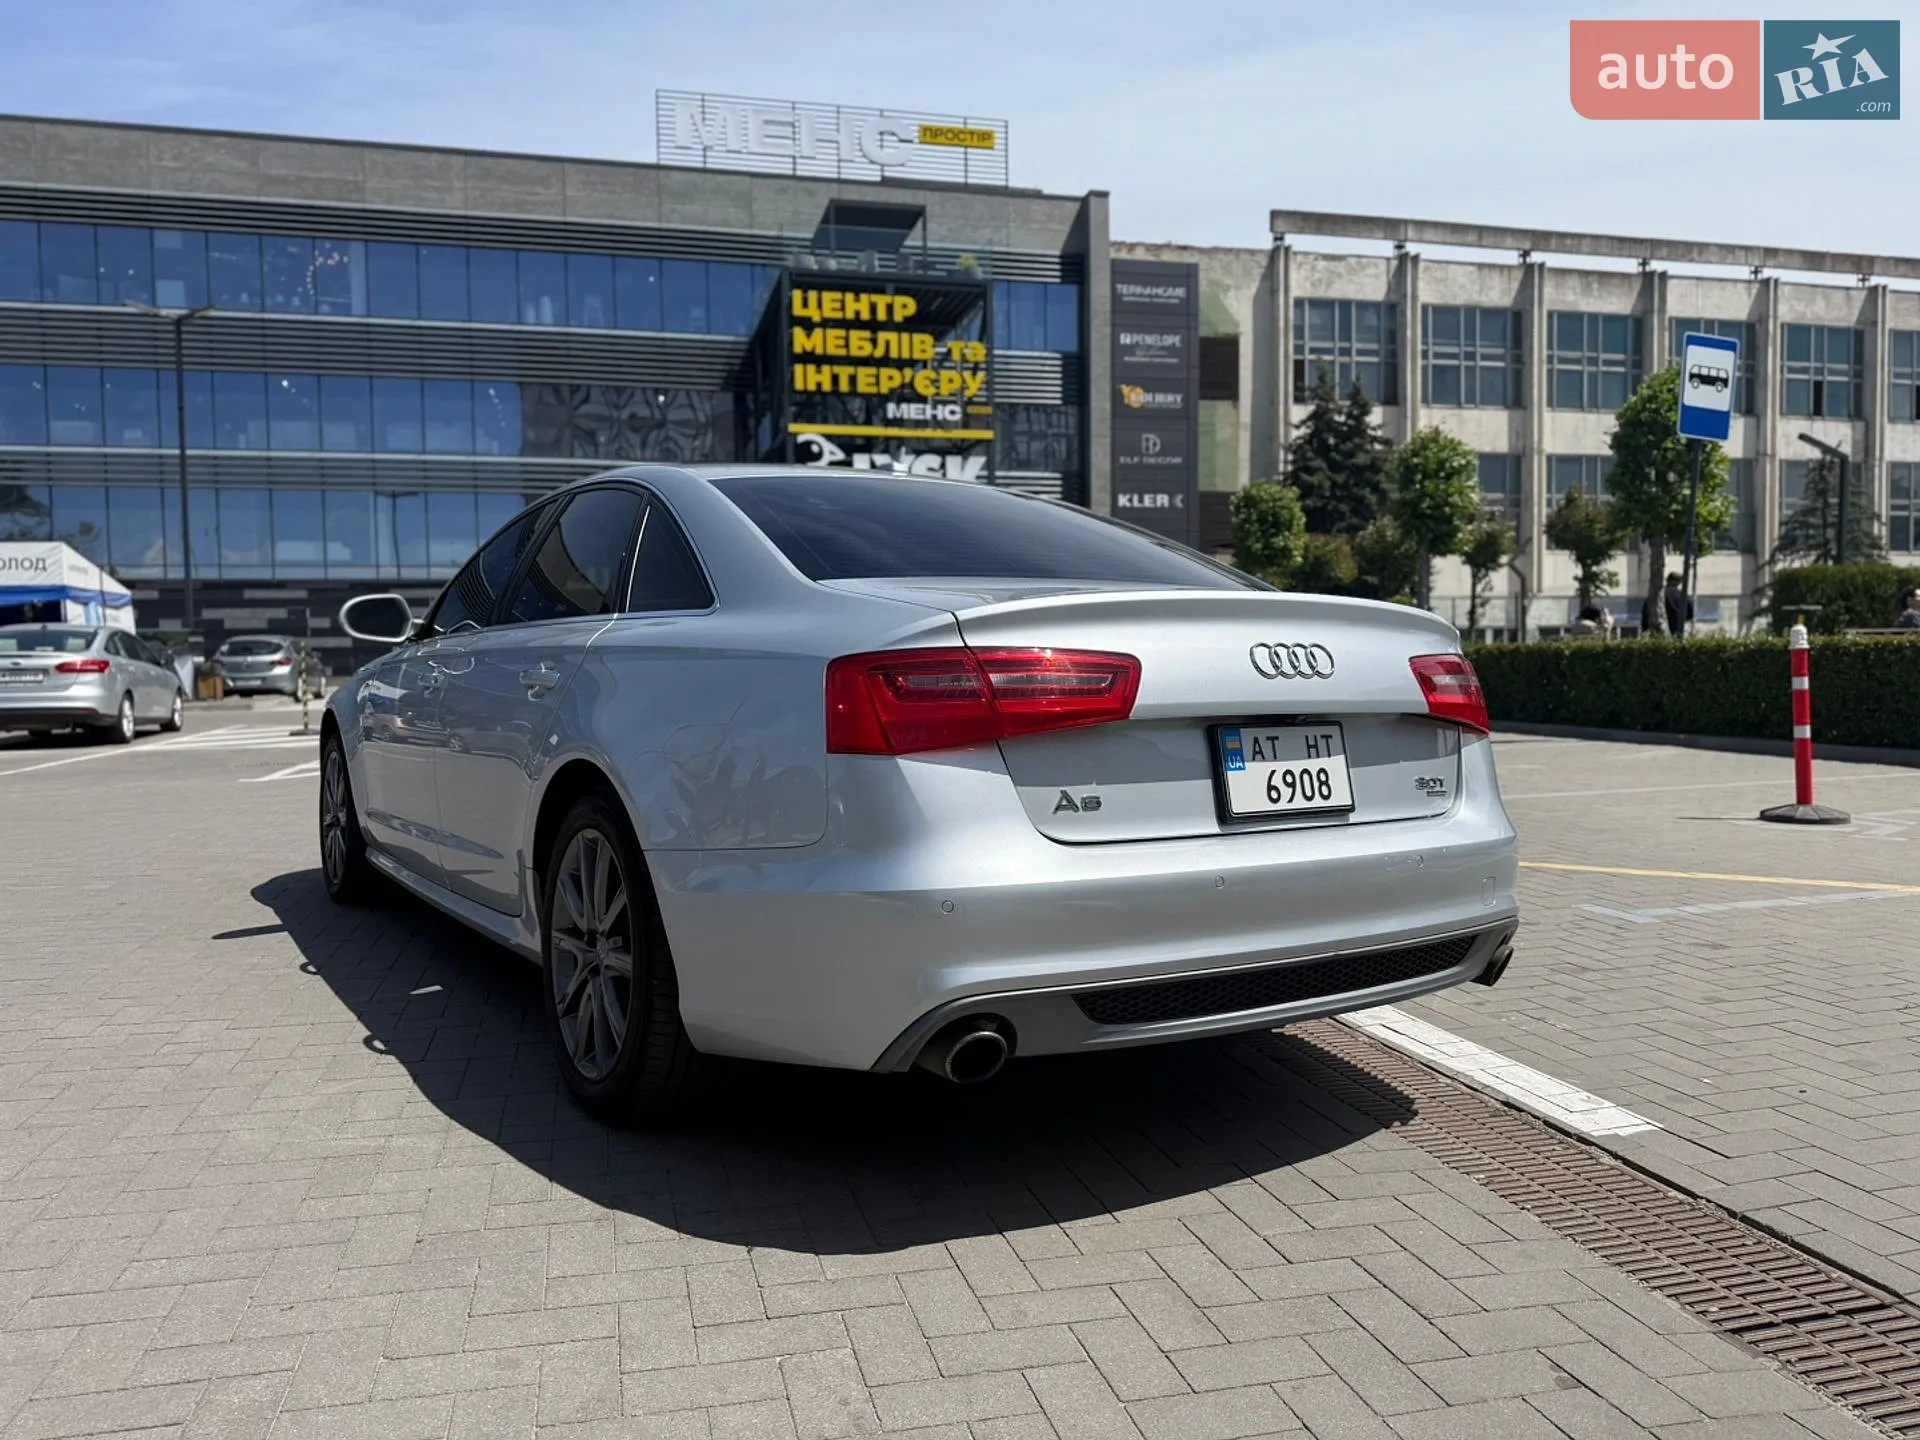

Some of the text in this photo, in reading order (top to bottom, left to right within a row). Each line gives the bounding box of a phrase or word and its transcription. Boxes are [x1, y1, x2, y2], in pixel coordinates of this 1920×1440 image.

[674, 100, 993, 166] МЕНС ПРОСТІР
[791, 289, 917, 323] ЦЕНТР
[792, 326, 987, 363] МЕБЛІВ та
[793, 363, 986, 397] ІНТЕР'ЄРУ
[886, 402, 962, 421] МЕНС
[1117, 494, 1170, 508] KLER
[1228, 755, 1243, 768] UA
[1251, 734, 1333, 761] AT HT
[1266, 767, 1332, 804] 6908
[1052, 790, 1102, 814] A6
